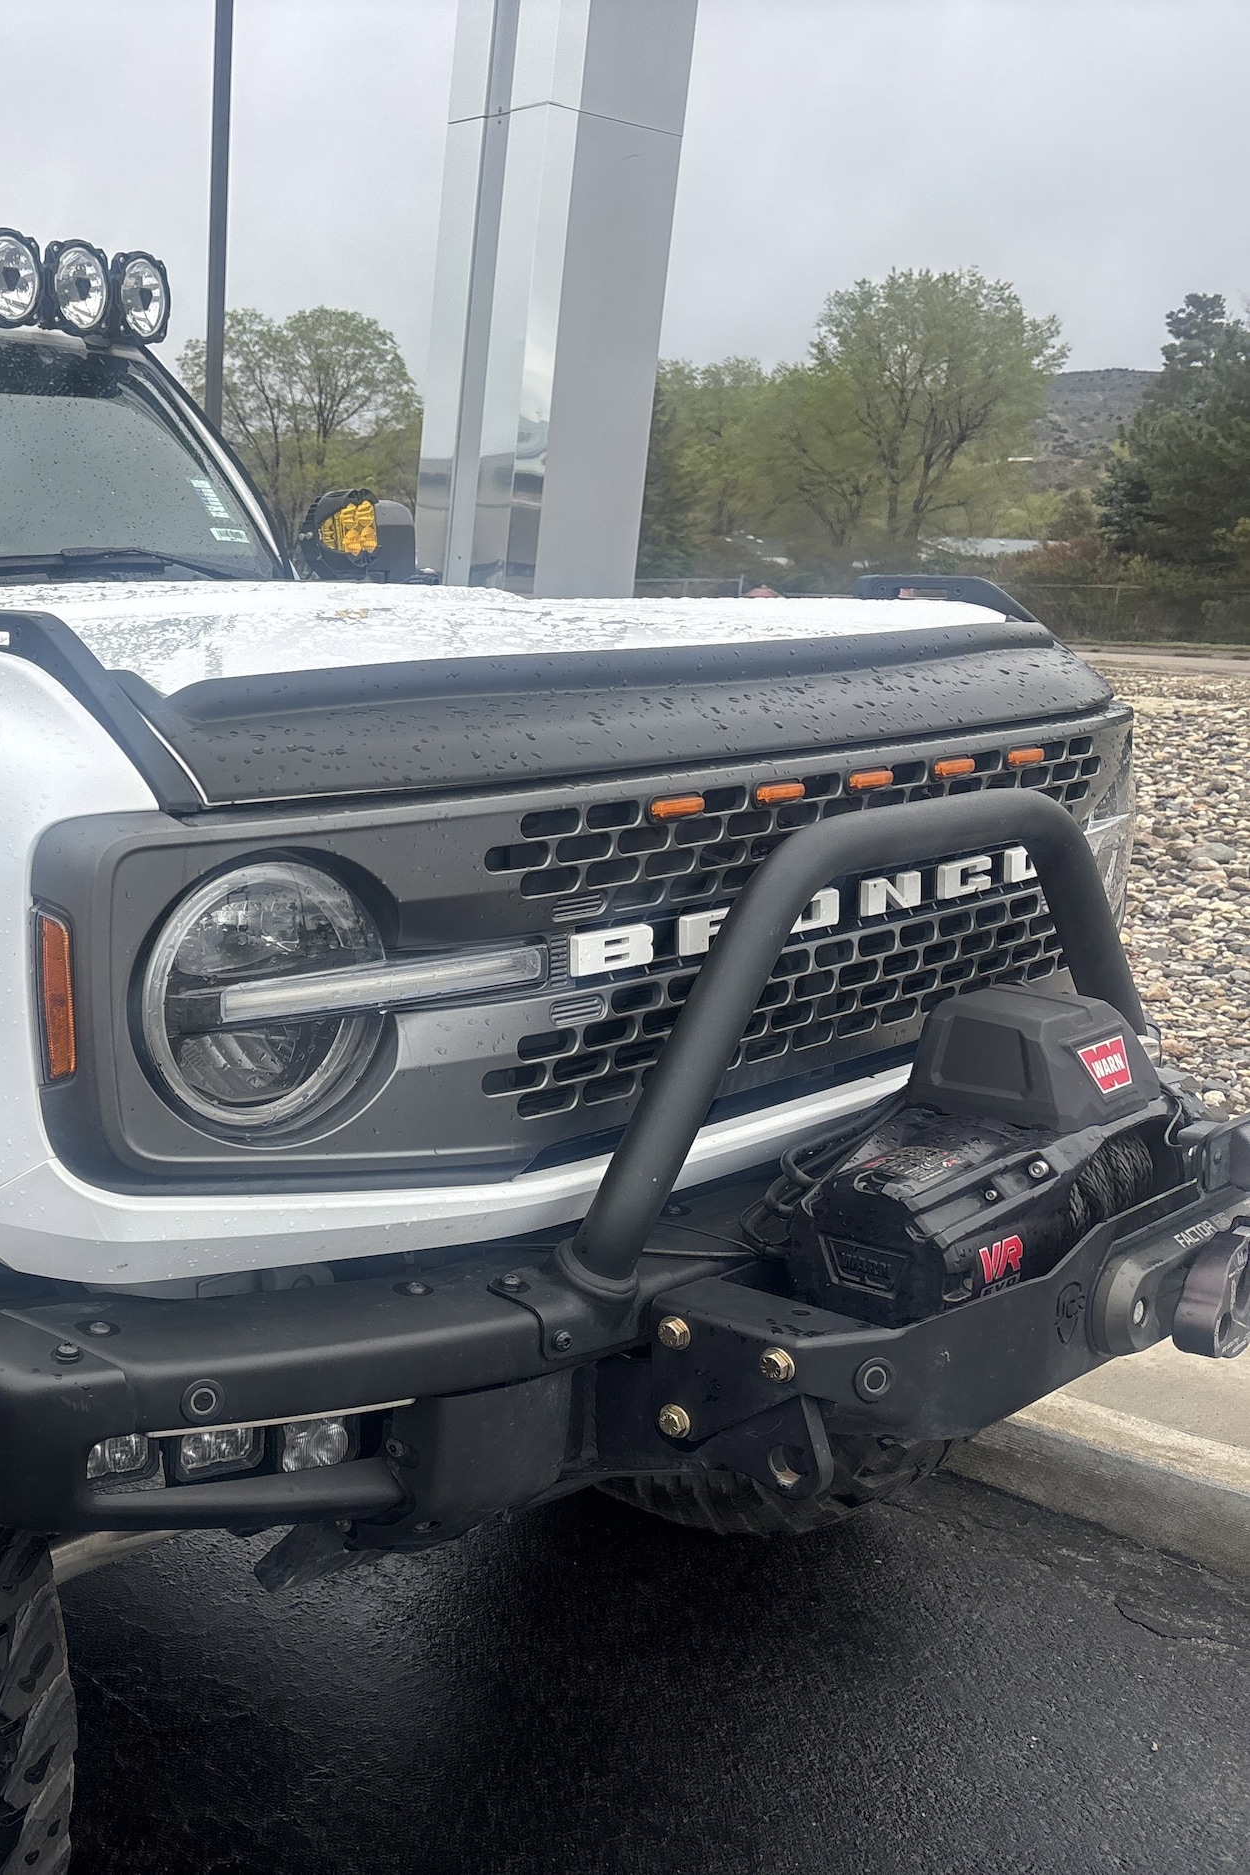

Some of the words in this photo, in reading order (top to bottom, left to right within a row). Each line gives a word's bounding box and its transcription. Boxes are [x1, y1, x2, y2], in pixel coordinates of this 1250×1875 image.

[1091, 1053, 1125, 1079] WARN
[1173, 1220, 1217, 1249] FACTOR
[979, 1235, 1023, 1284] VR
[983, 1274, 1018, 1298] EVO
